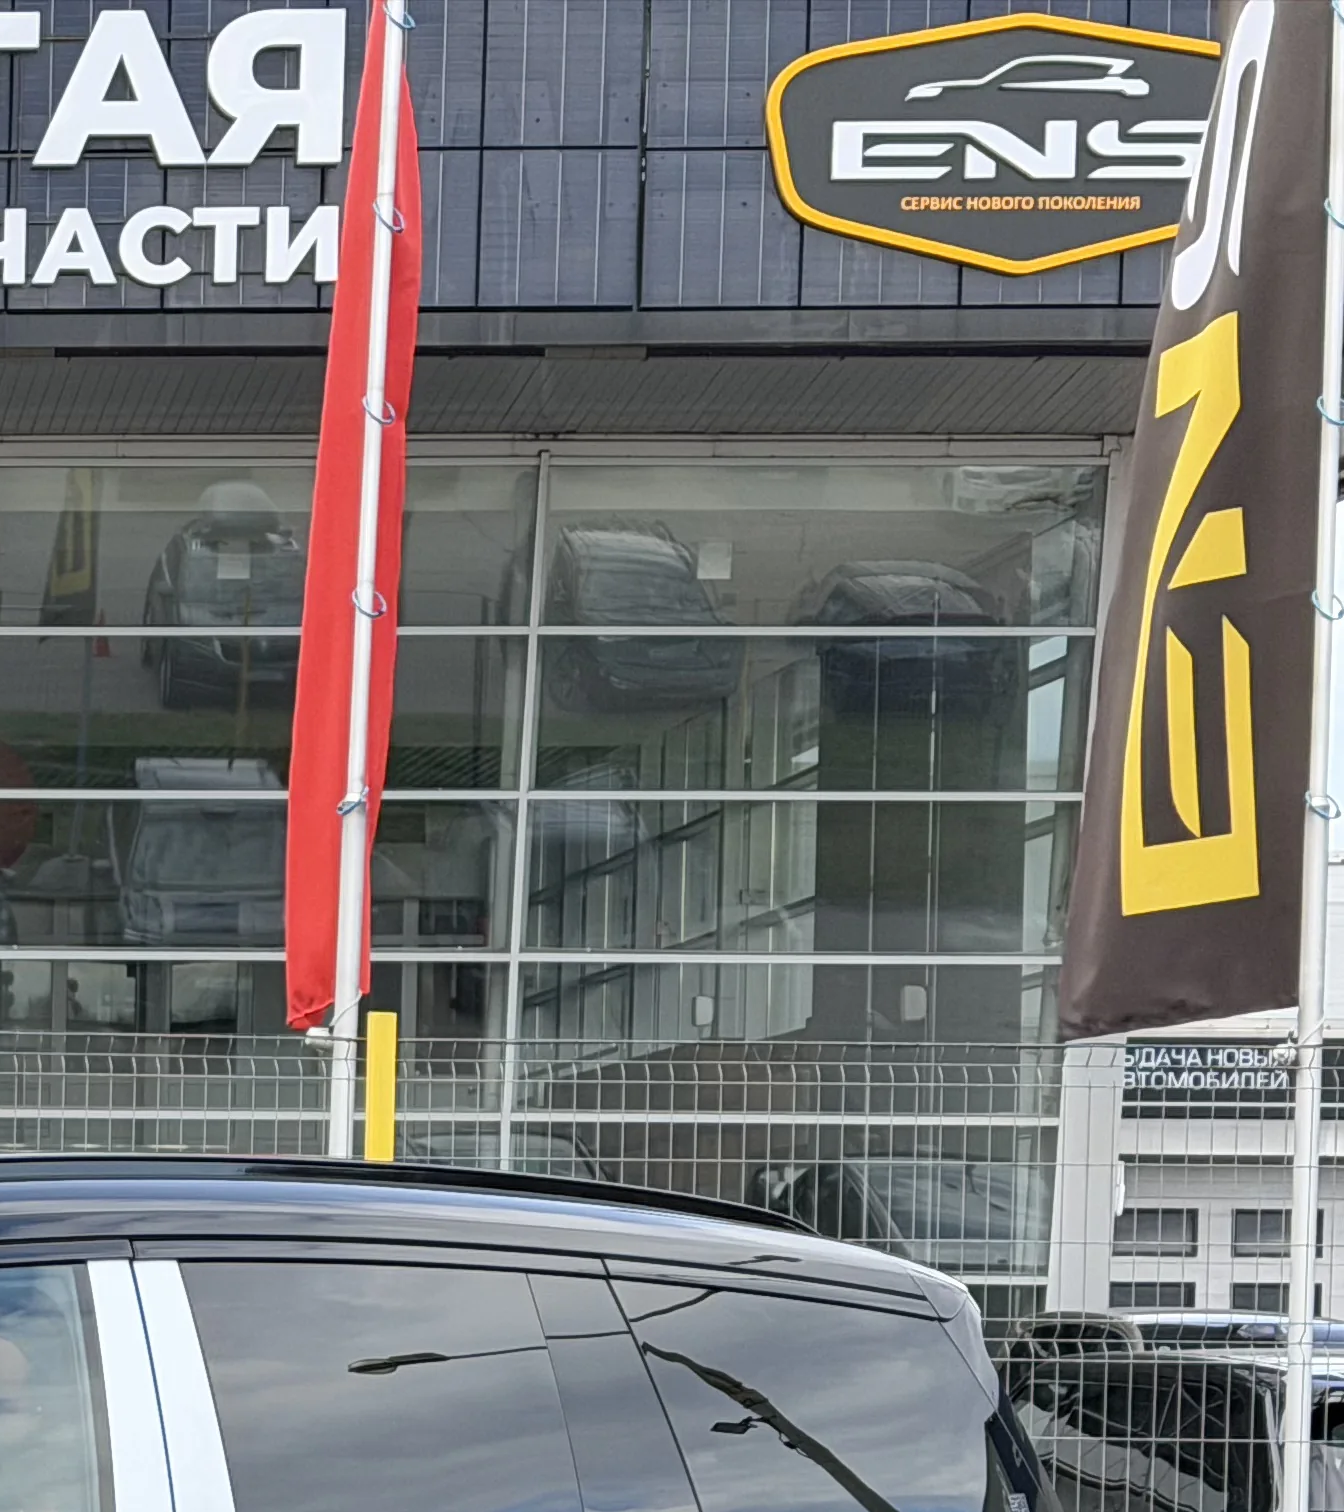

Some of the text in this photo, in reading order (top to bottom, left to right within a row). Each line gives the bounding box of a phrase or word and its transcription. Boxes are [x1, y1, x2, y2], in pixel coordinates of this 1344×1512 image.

[830, 119, 1210, 181] ENS
[900, 195, 1142, 211] СЕРВИС НОВОГО ПОКОЛЕНИЯ
[1123, 1047, 1276, 1067] ЫДАЧА НОВЫ
[1123, 1069, 1289, 1089] ВТОМОБИЛЕЙ
